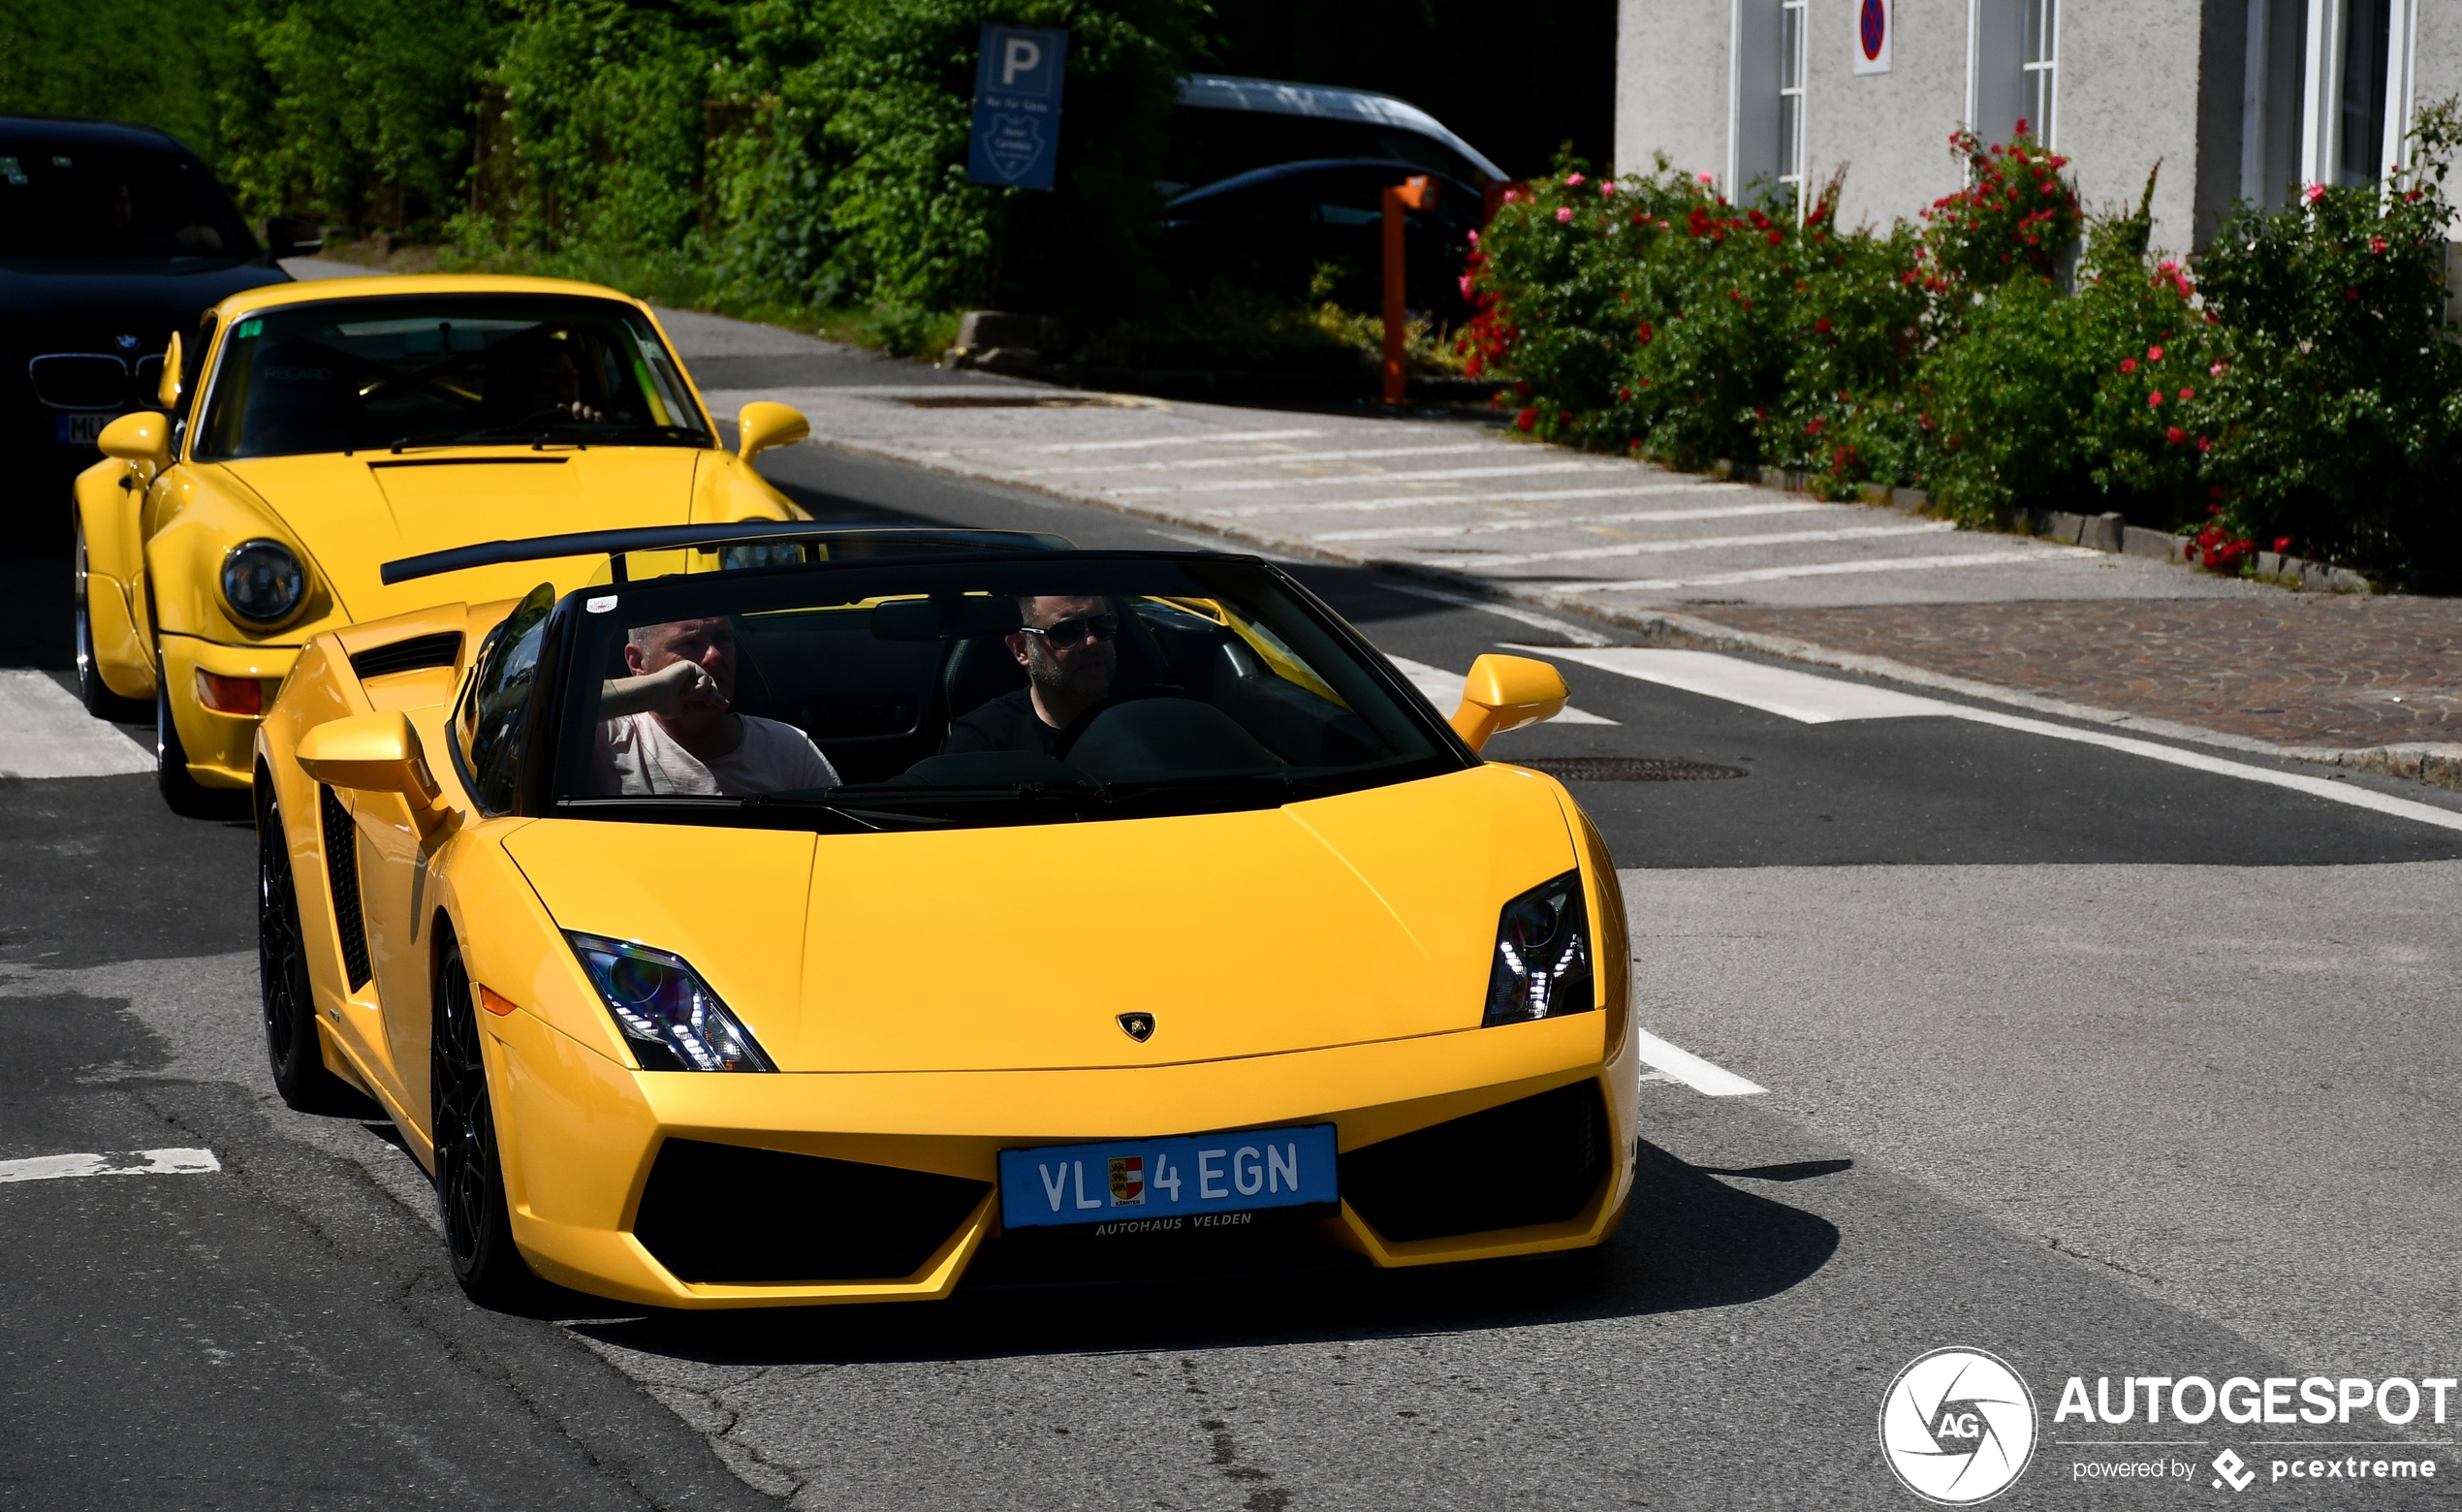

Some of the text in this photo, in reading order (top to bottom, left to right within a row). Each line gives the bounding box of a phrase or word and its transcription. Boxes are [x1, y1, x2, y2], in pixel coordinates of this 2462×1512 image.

[1002, 39, 1041, 85] P
[264, 367, 332, 381] RECARO
[1038, 1142, 1299, 1213] VL 4 EGN
[1095, 1213, 1251, 1237] AUTOHAUS VELDEN
